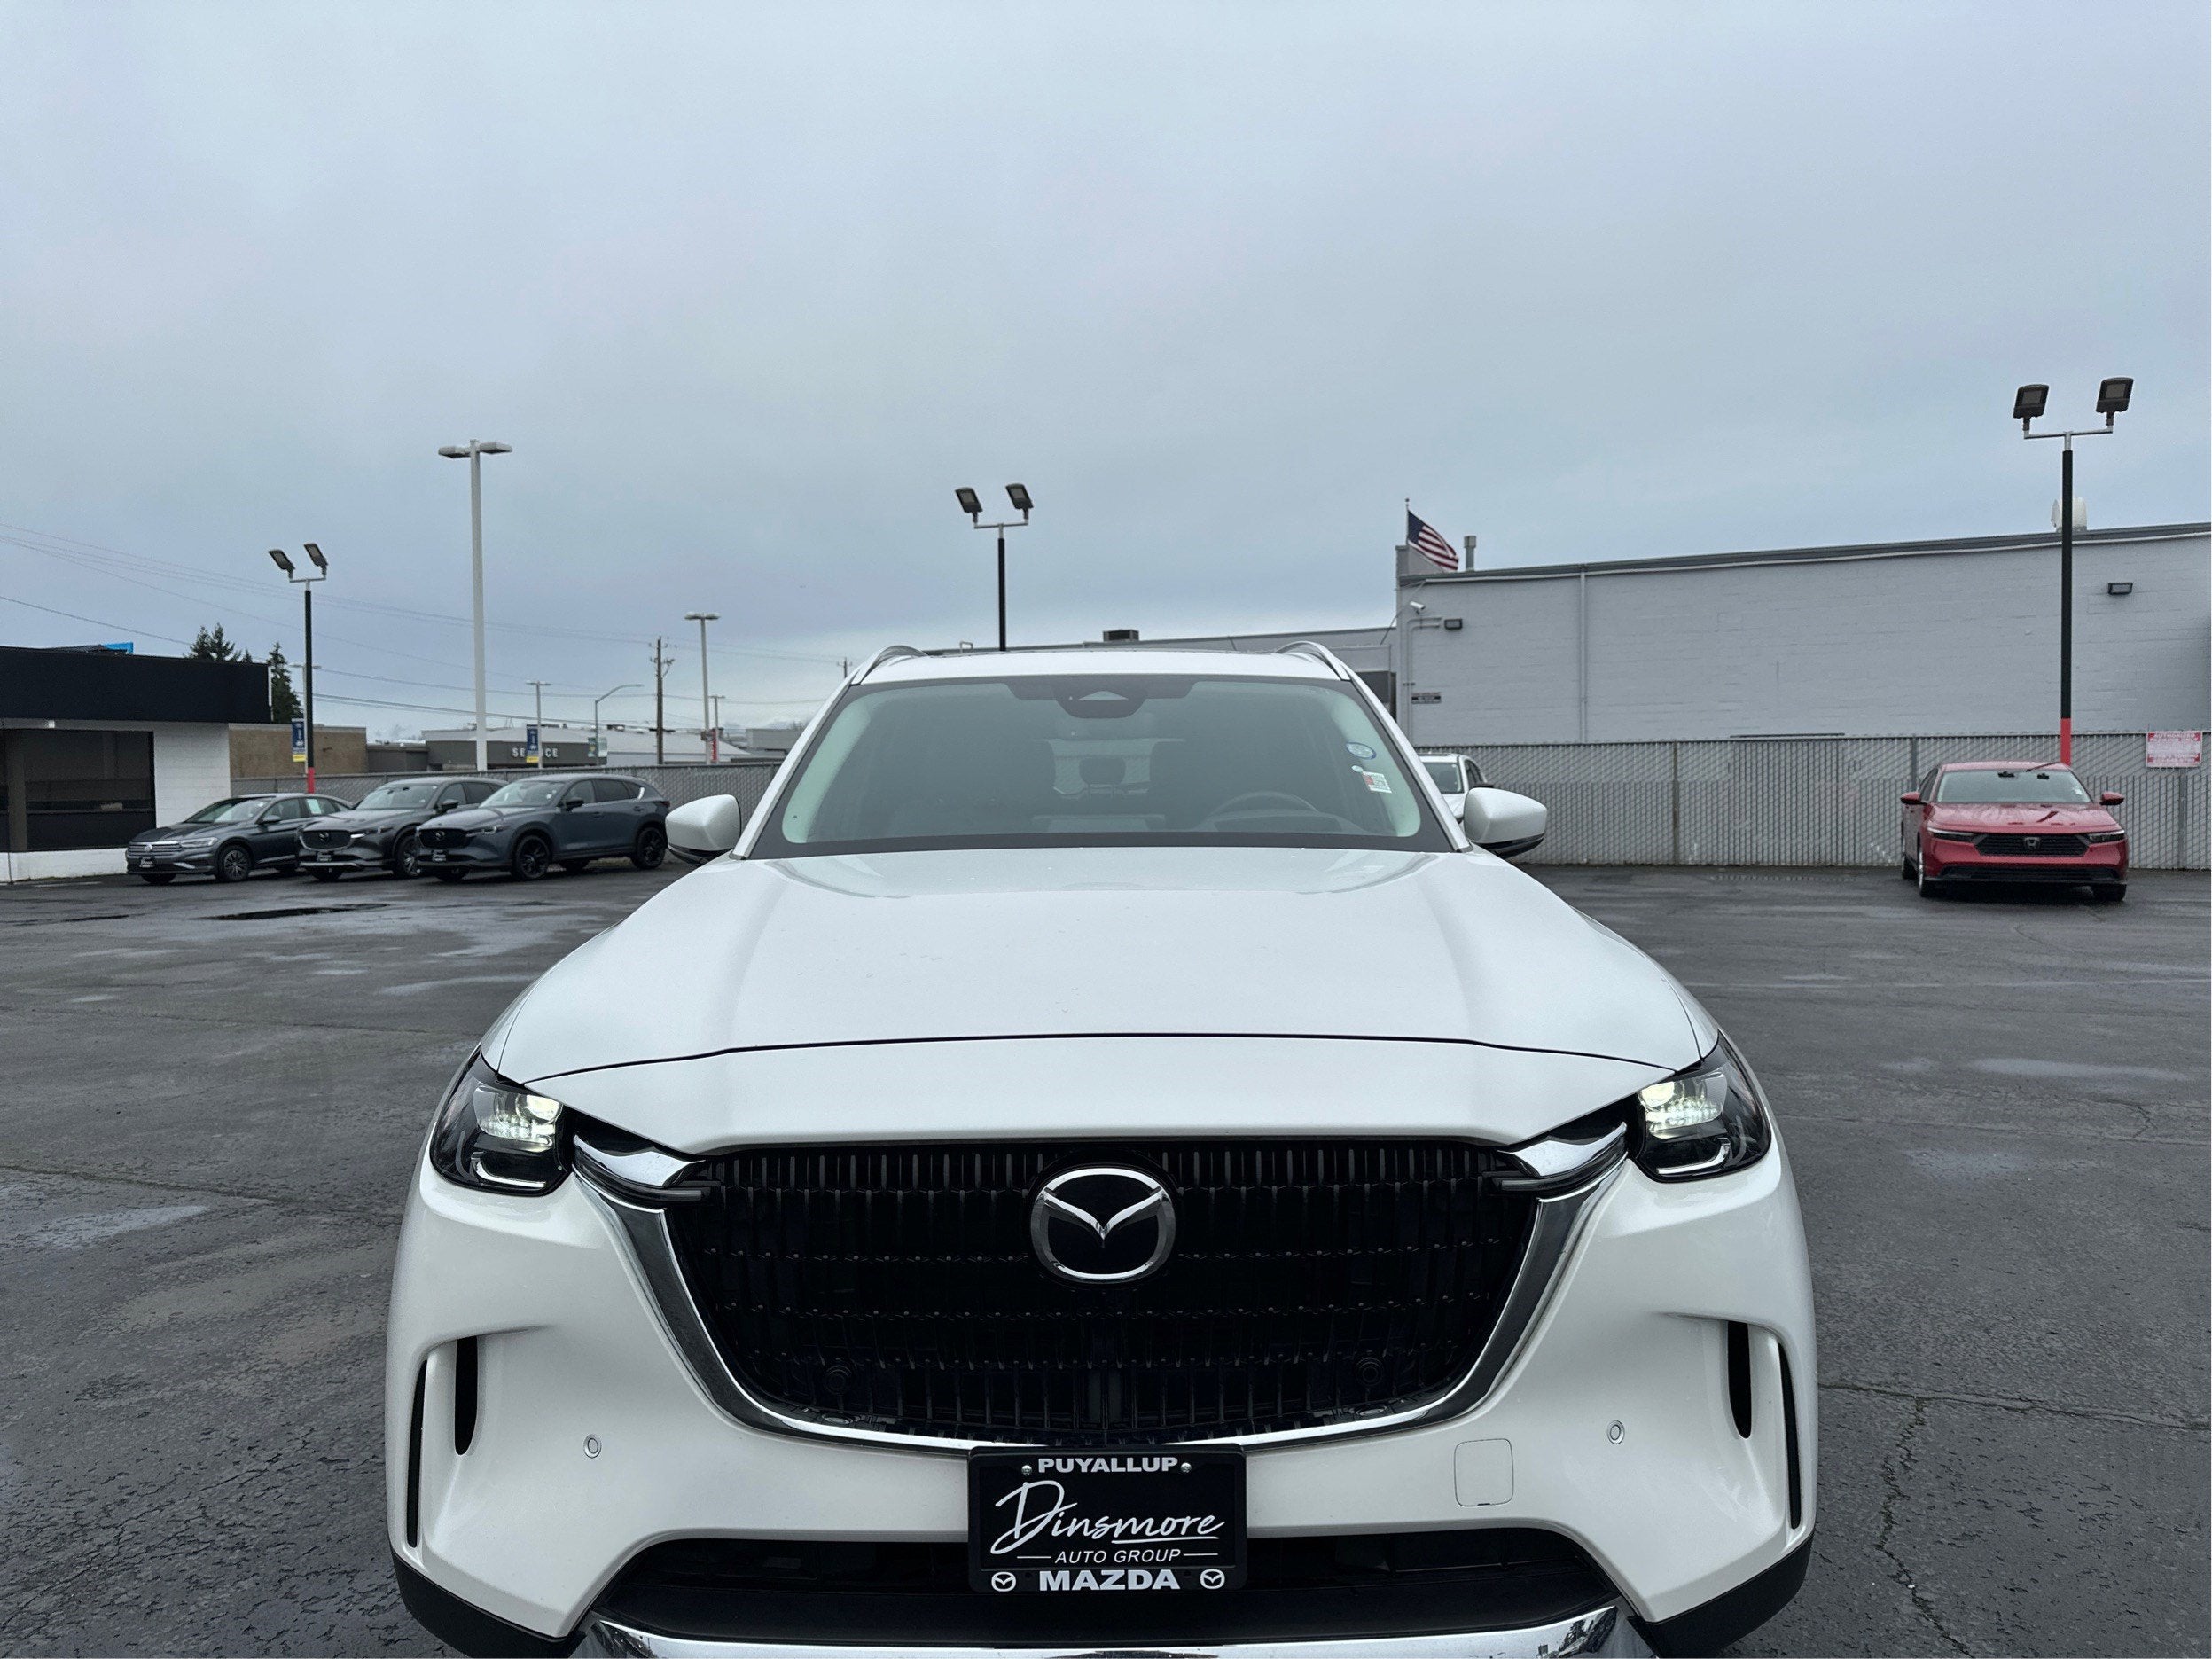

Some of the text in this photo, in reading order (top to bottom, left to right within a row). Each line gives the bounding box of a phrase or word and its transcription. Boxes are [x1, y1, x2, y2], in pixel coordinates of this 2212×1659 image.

[512, 747, 559, 758] SECE
[1038, 1457, 1178, 1473] PUYALLUP
[990, 1480, 1225, 1555] Dinsmore
[1055, 1548, 1181, 1564] AUTO GROUP
[1039, 1569, 1180, 1592] MAZDA
